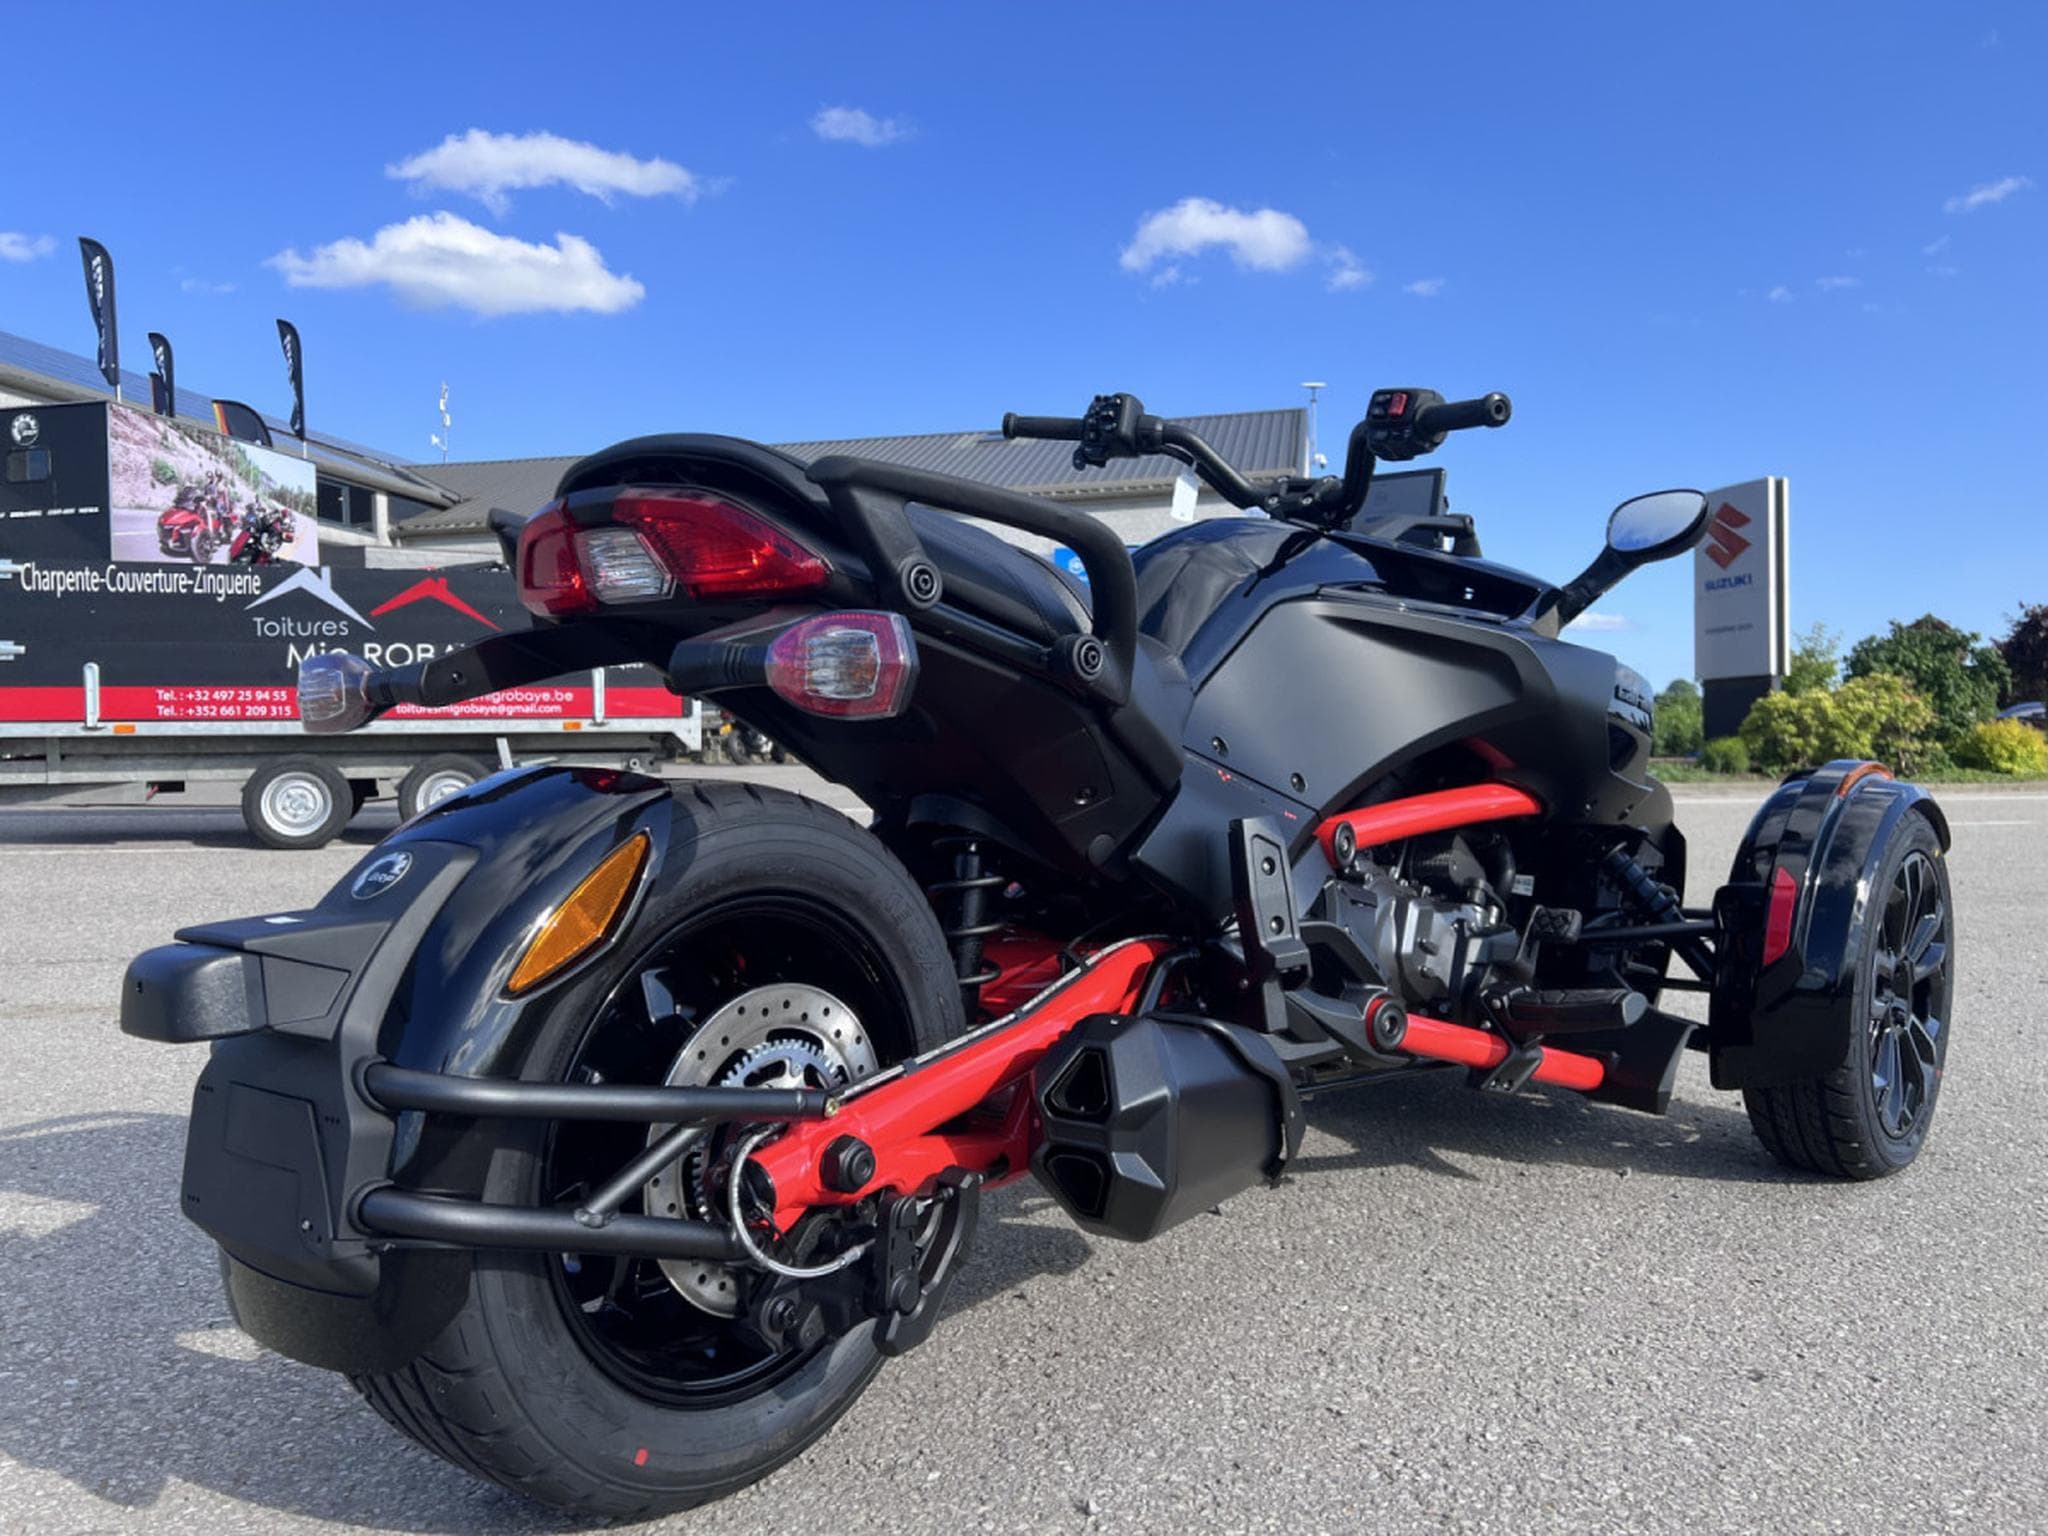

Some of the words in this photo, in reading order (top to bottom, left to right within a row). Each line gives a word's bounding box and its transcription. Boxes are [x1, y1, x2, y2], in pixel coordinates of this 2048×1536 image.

[21, 562, 261, 602] Charpente-Couverture-Zinguerie
[252, 617, 349, 637] Toitures
[364, 643, 465, 668] ROB
[156, 689, 176, 701] Tel.
[186, 690, 210, 701] +32
[212, 690, 235, 701] 497
[237, 690, 252, 701] 25
[255, 690, 270, 701] 94
[272, 690, 288, 701] 55
[156, 704, 176, 717] Tel.
[186, 705, 217, 717] +352
[219, 705, 241, 717] 661
[244, 705, 267, 717] 209
[270, 705, 292, 717] 315
